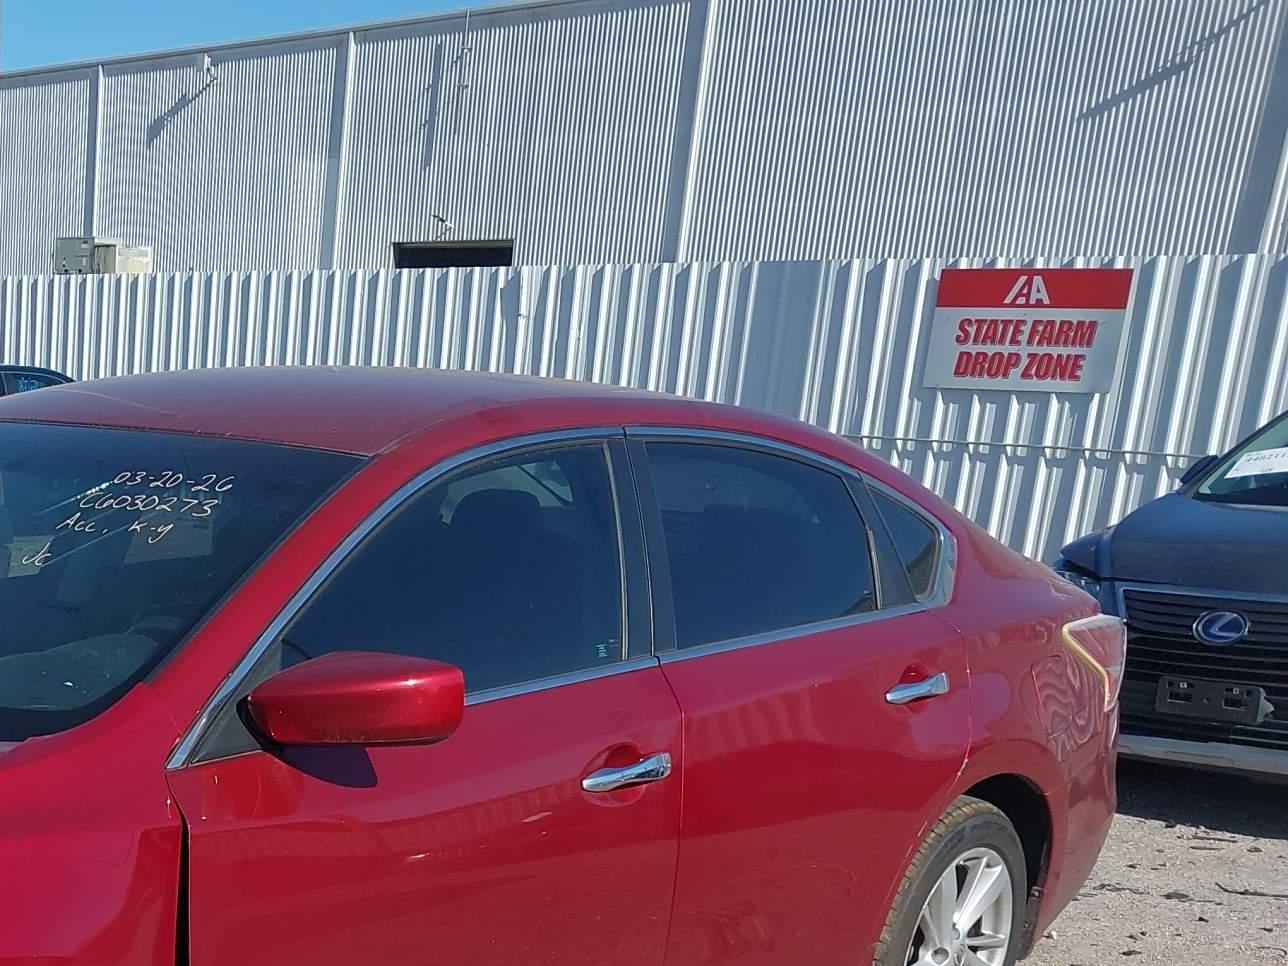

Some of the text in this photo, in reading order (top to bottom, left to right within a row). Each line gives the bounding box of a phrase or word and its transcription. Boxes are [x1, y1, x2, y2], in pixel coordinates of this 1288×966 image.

[955, 318, 1097, 347] STATE FARM
[953, 351, 1085, 381] DROP ZONE
[113, 471, 235, 492] 03-20-26
